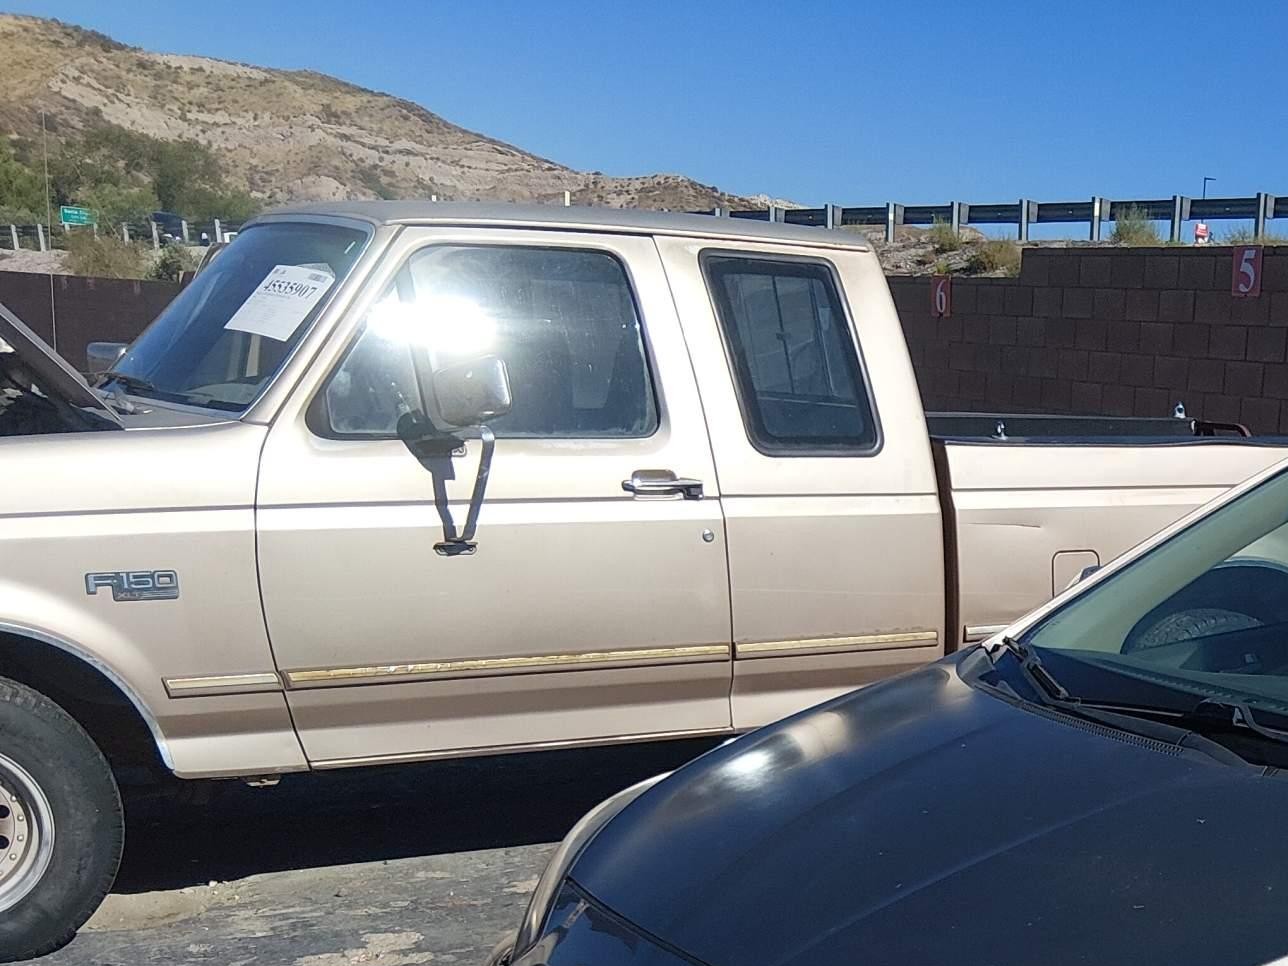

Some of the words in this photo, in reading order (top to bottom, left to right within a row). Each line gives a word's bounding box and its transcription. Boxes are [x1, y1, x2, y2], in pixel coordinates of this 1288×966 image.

[1239, 250, 1257, 292] 5
[264, 279, 317, 299] 45535907
[934, 279, 947, 313] 6
